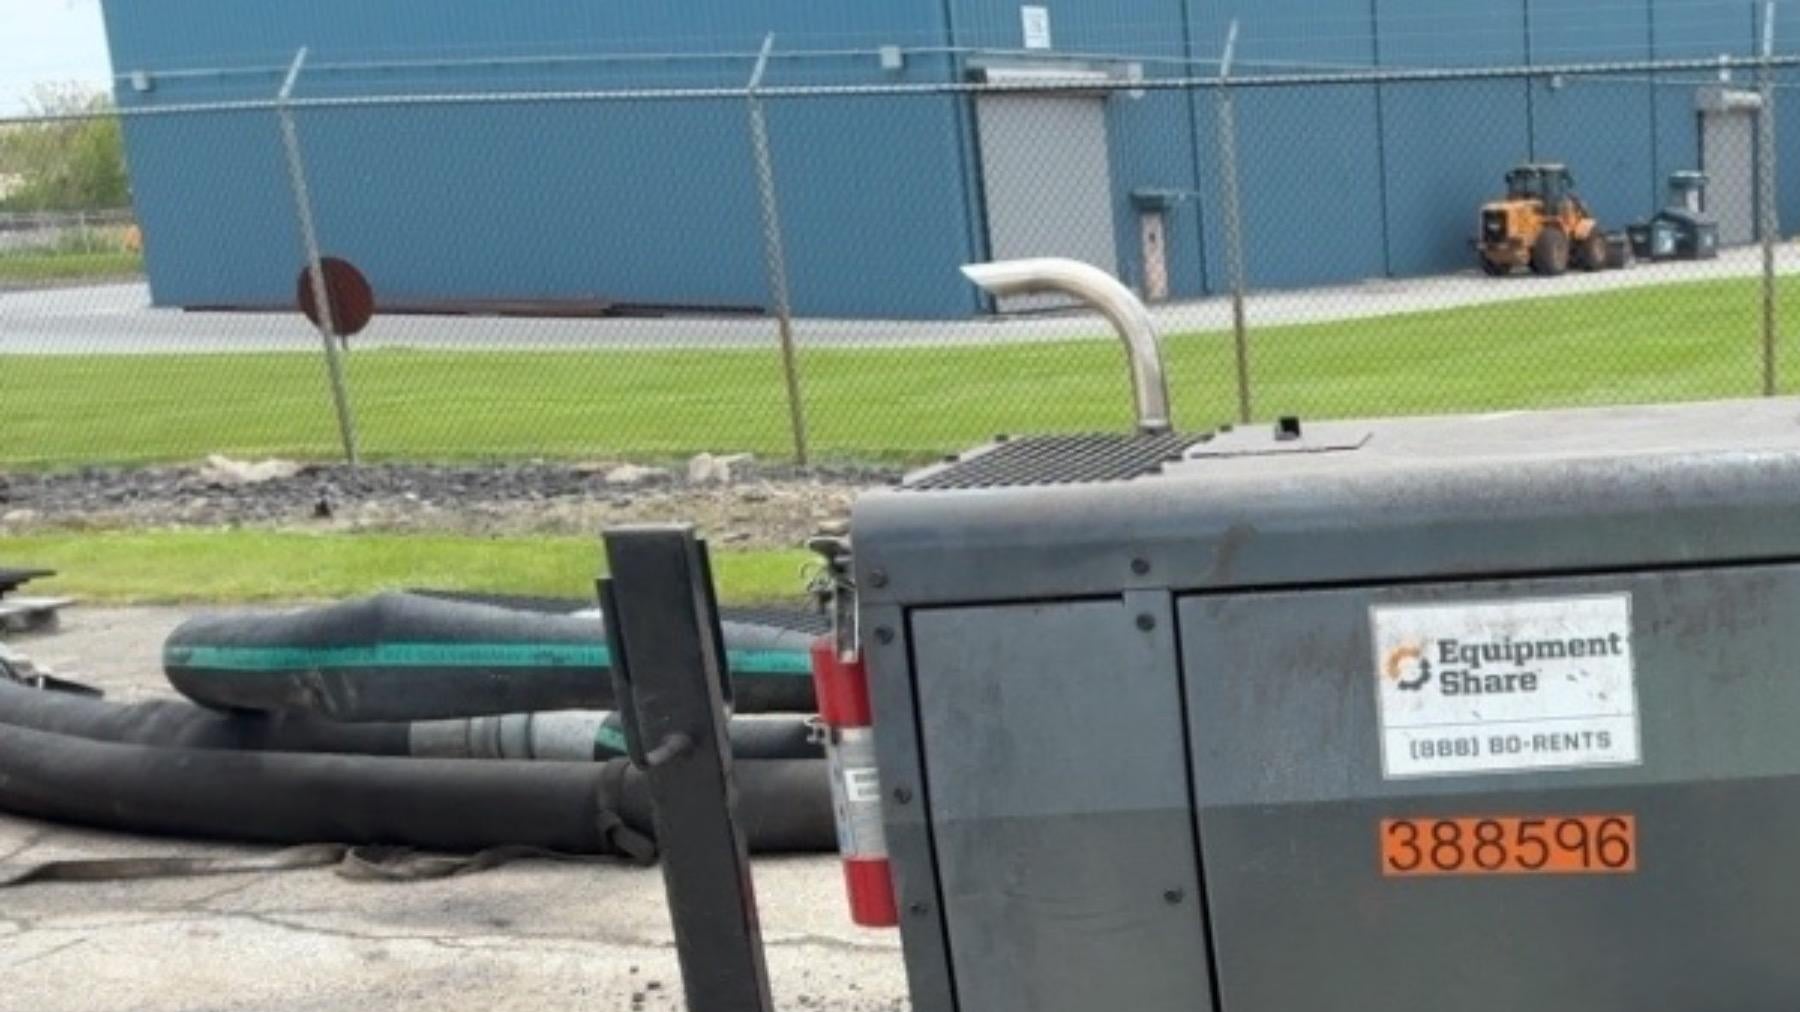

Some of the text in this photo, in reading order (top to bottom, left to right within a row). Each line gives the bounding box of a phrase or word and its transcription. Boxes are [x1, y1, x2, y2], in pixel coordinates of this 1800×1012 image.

[1437, 632, 1623, 667] Equipment
[1439, 670, 1538, 697] Share
[1387, 816, 1632, 872] 388596
